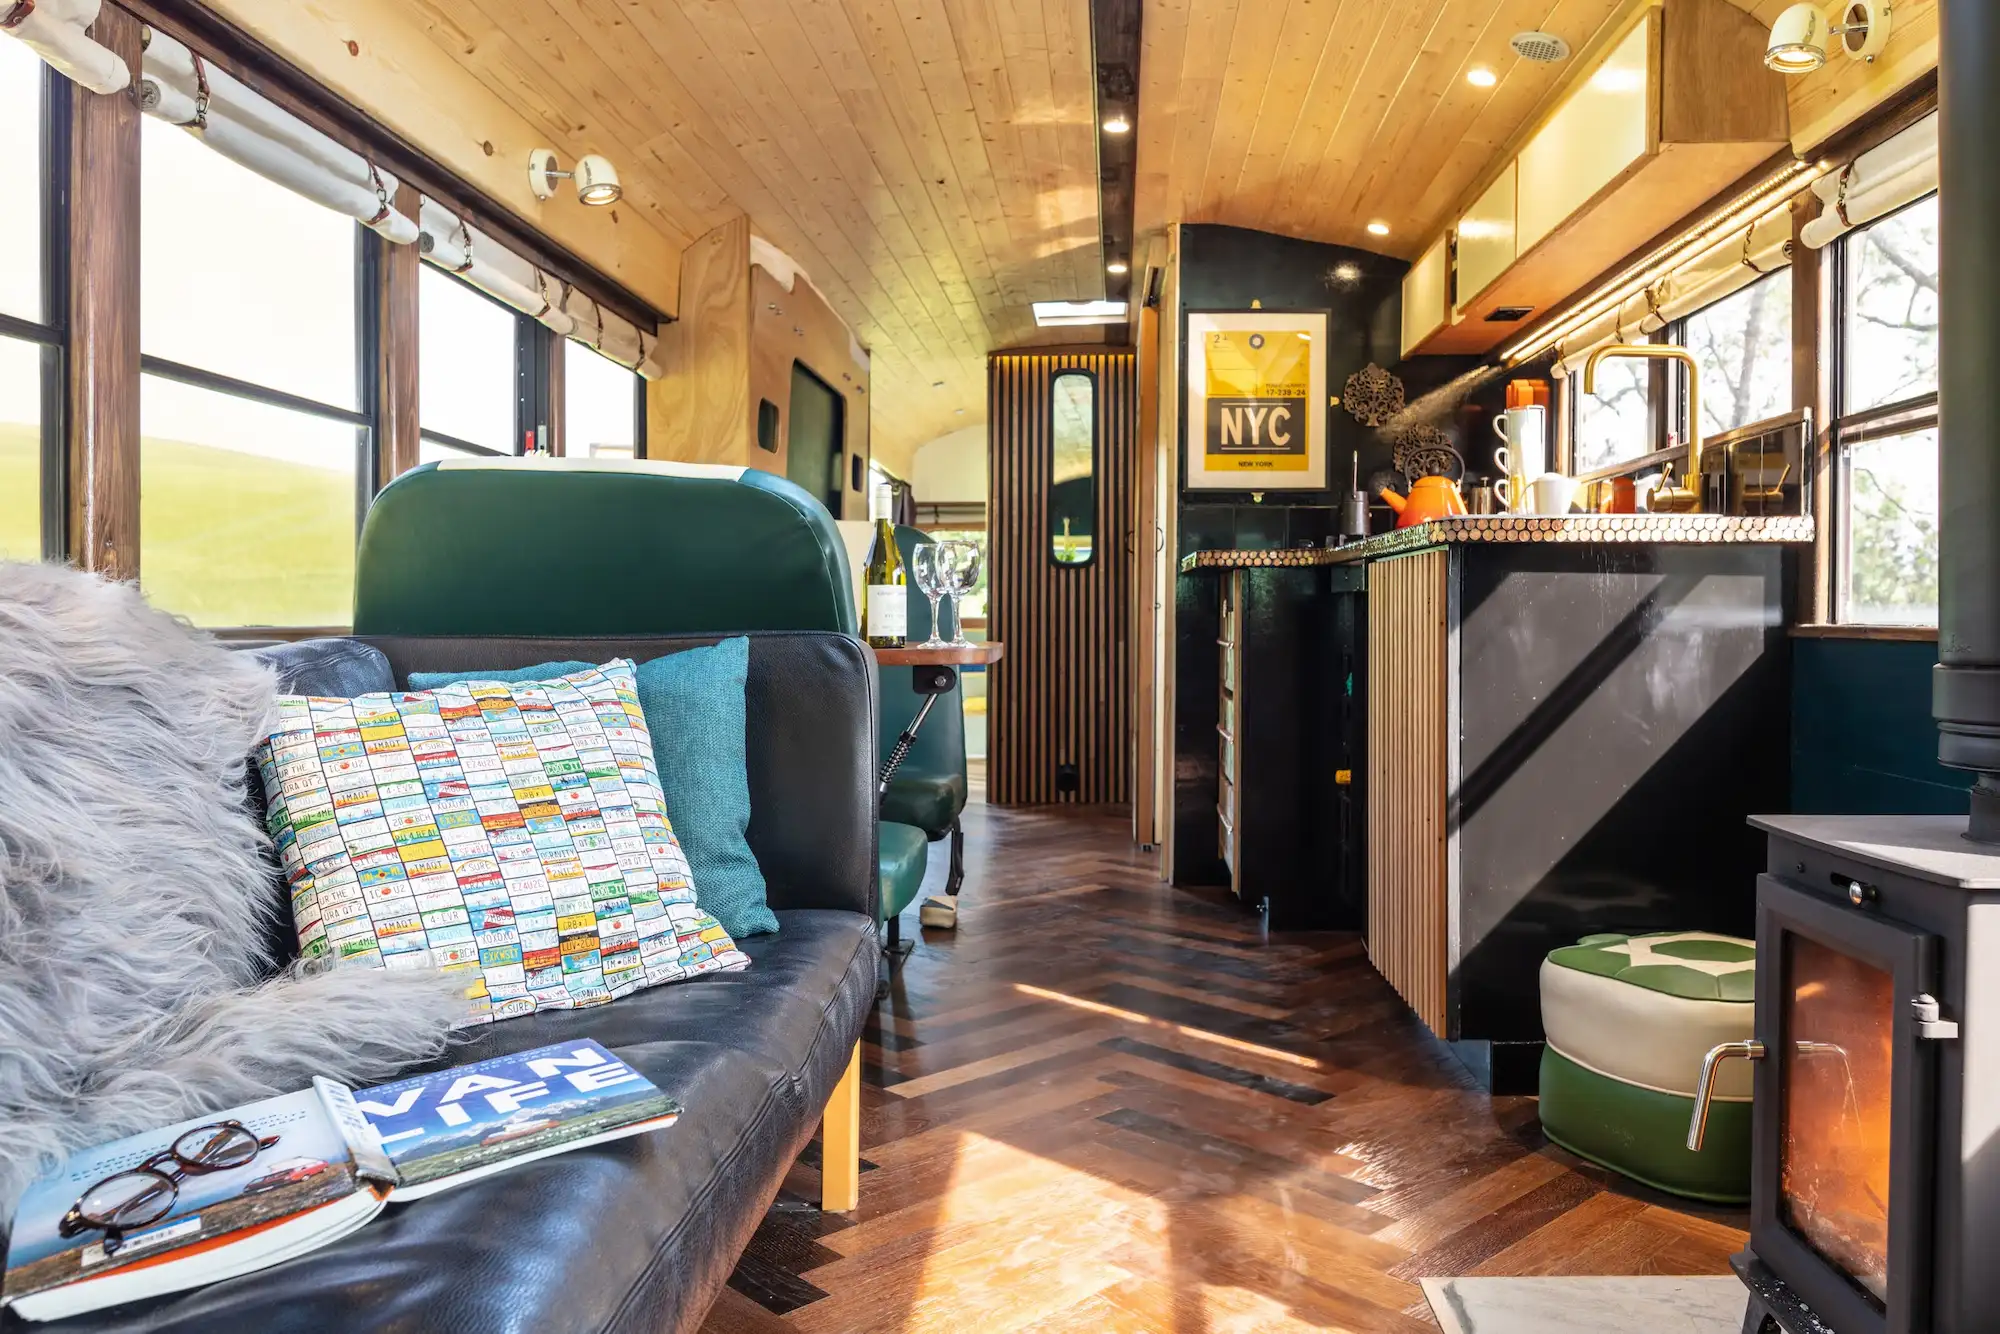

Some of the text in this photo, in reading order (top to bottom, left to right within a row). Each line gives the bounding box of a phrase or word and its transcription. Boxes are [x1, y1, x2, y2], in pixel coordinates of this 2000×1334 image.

[1221, 407, 1291, 446] NYC
[292, 763, 307, 773] THE
[414, 860, 442, 872] IMAQT
[469, 861, 491, 871] SURE
[331, 890, 347, 901] THE
[323, 909, 339, 922] URA
[383, 919, 413, 931] IMAQT
[481, 933, 513, 944] XOXOXO
[653, 936, 674, 949] FREE
[459, 948, 475, 958] BCH
[606, 960, 616, 970] IM
[623, 955, 637, 965] GR8
[507, 1001, 529, 1013] SURE
[356, 1048, 608, 1117] VAN
[369, 1062, 639, 1144] LIFE
